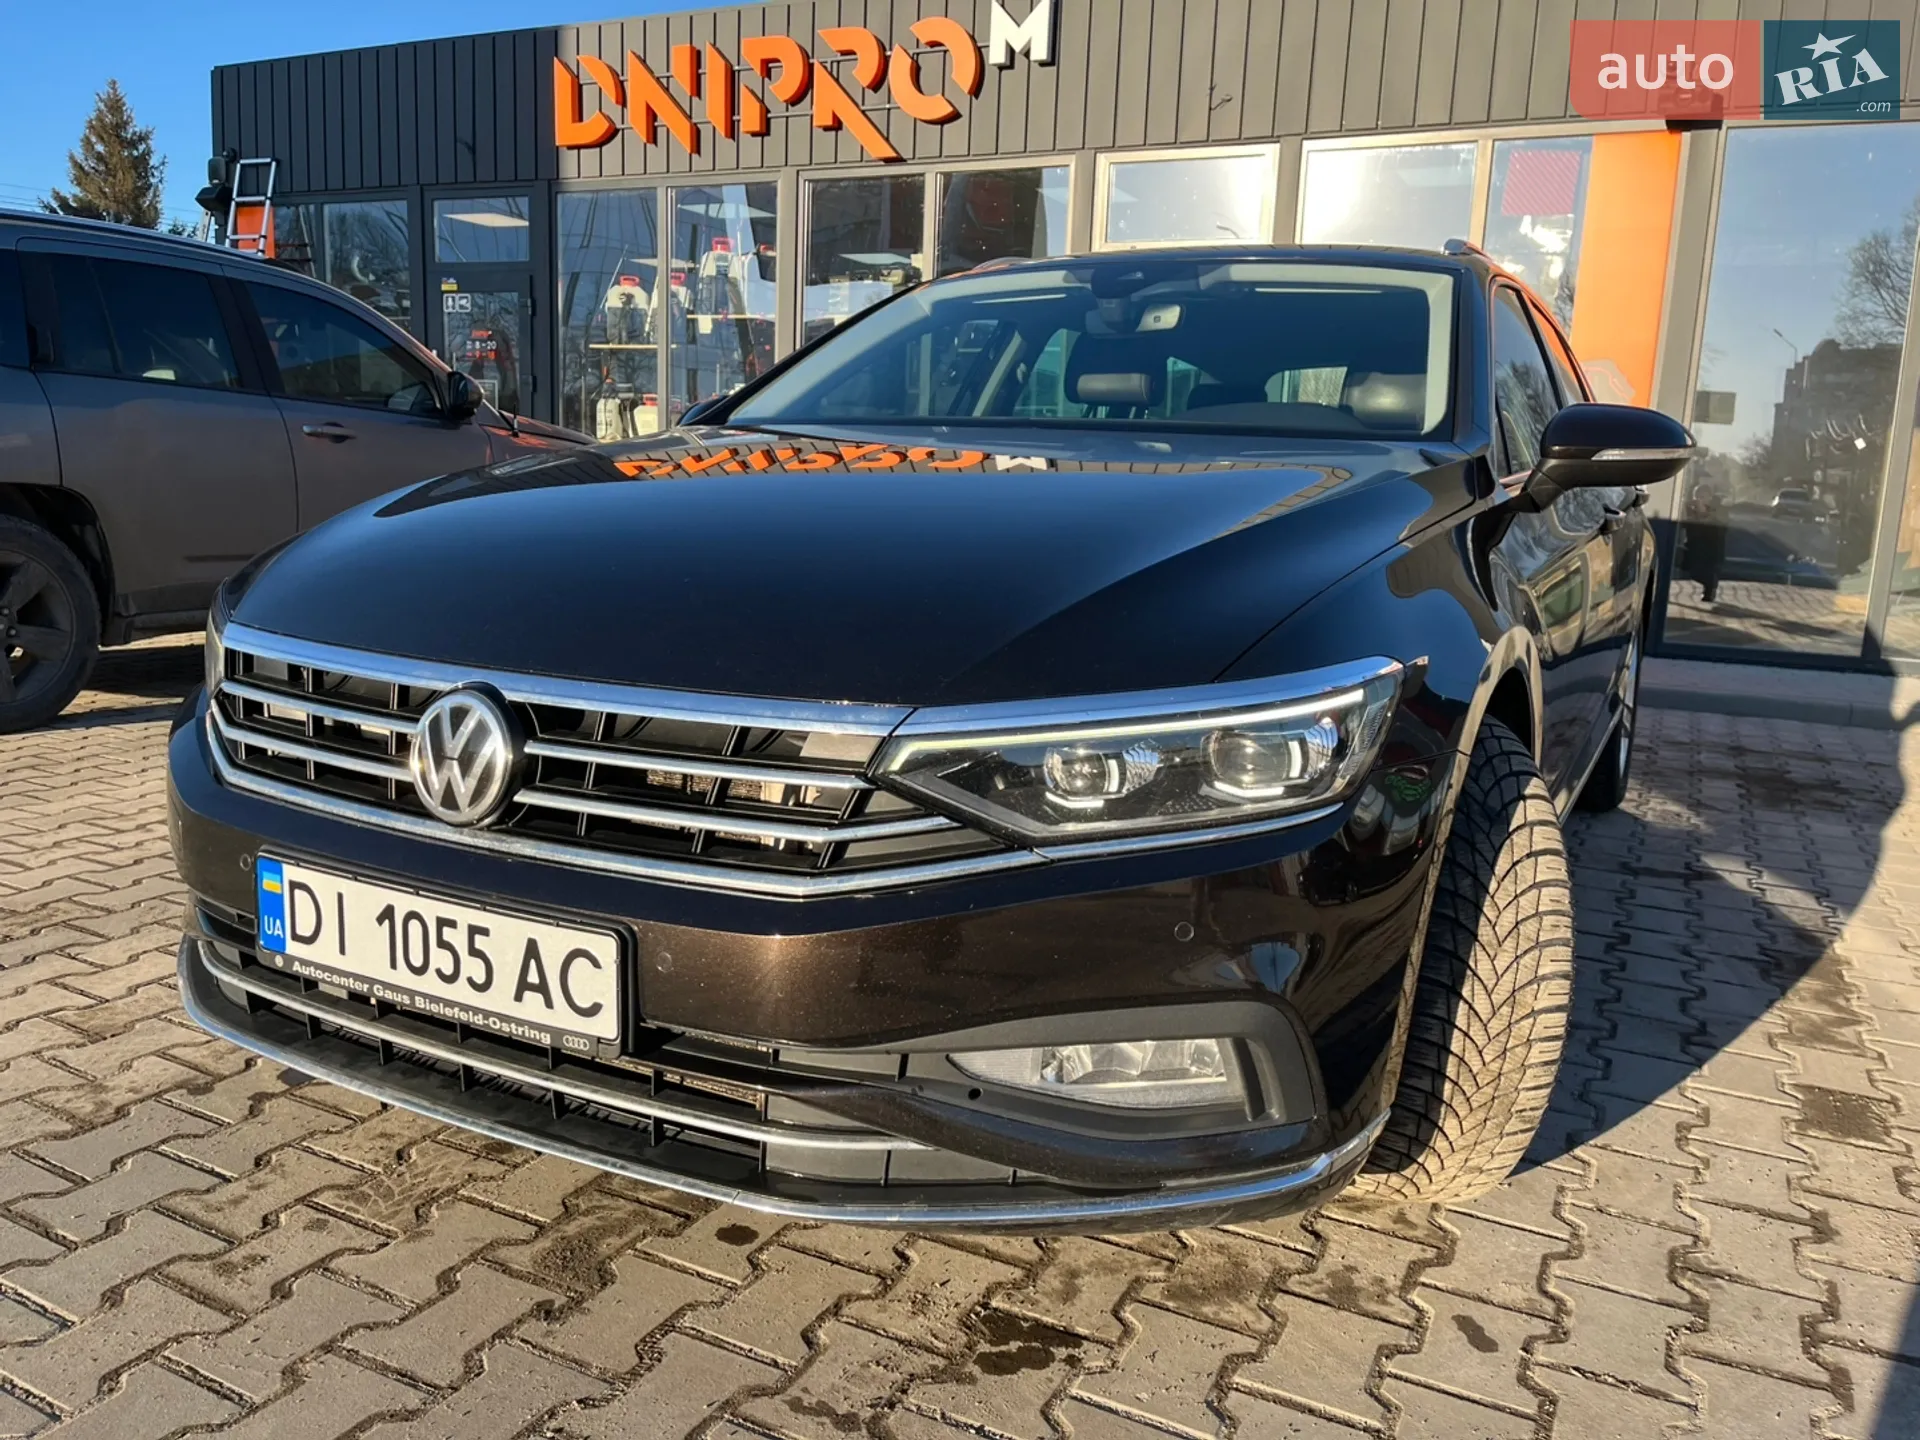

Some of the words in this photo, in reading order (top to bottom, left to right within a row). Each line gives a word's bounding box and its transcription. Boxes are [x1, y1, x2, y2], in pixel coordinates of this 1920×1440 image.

[554, 16, 985, 162] DNIPRO
[988, 0, 1055, 66] M
[264, 915, 284, 939] UA
[288, 879, 347, 957] DI
[376, 903, 494, 994] 1055
[513, 937, 604, 1018] AC
[292, 960, 370, 993] Autocenter
[373, 984, 411, 1005] Gaus
[414, 995, 551, 1045] Bielefeld-Ostring
